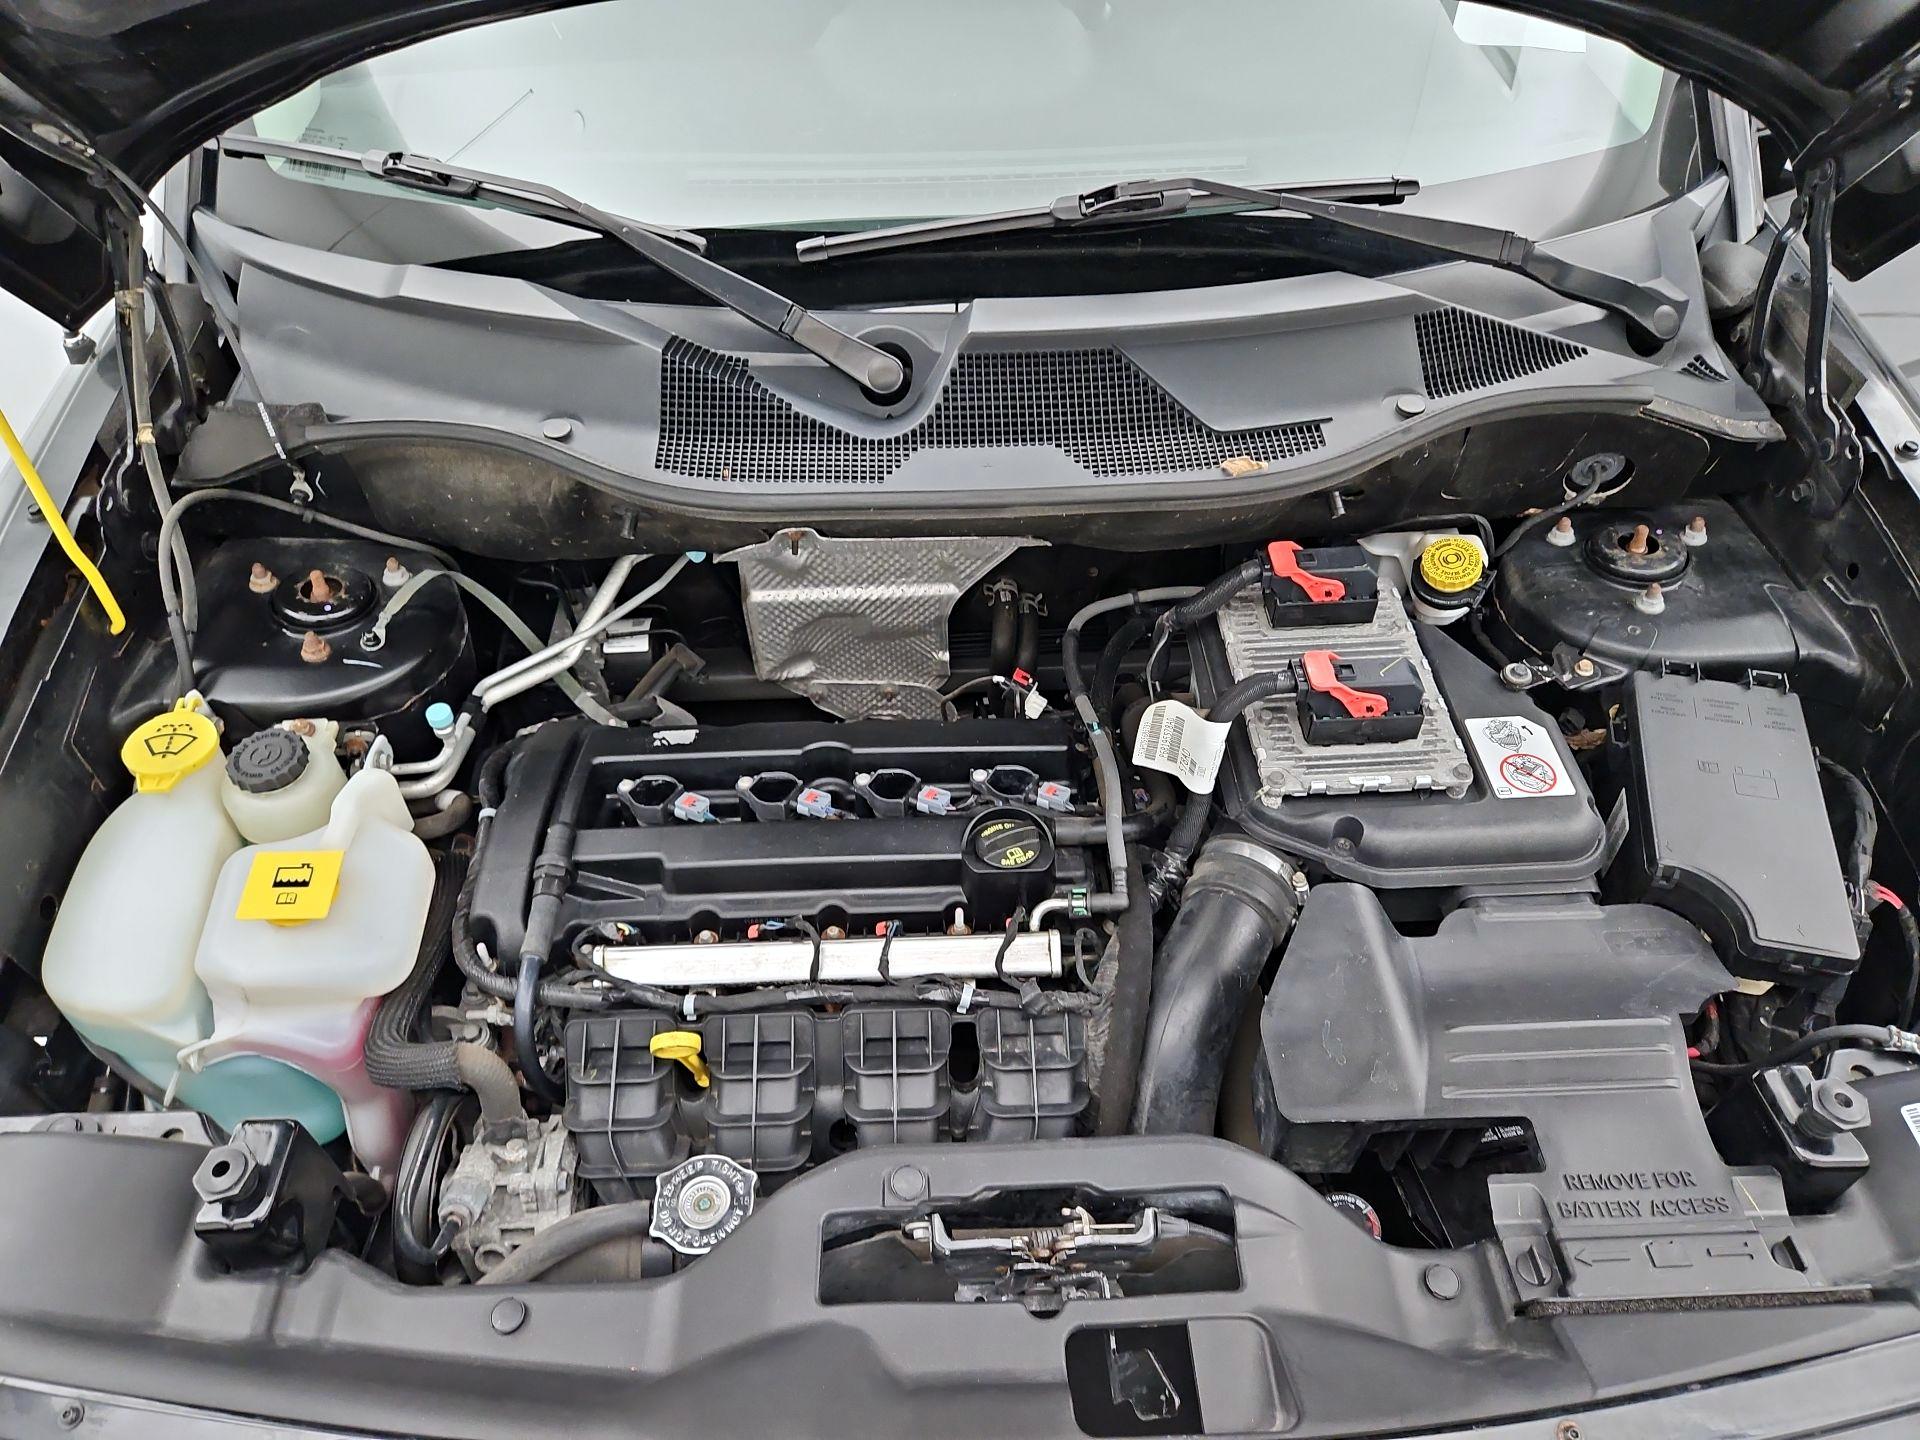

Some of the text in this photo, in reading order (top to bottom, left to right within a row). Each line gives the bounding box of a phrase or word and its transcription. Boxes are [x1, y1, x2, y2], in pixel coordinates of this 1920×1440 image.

[1563, 1170, 1697, 1191] REMOVE FOR
[1556, 1196, 1730, 1219] BATTERY ACCESS
